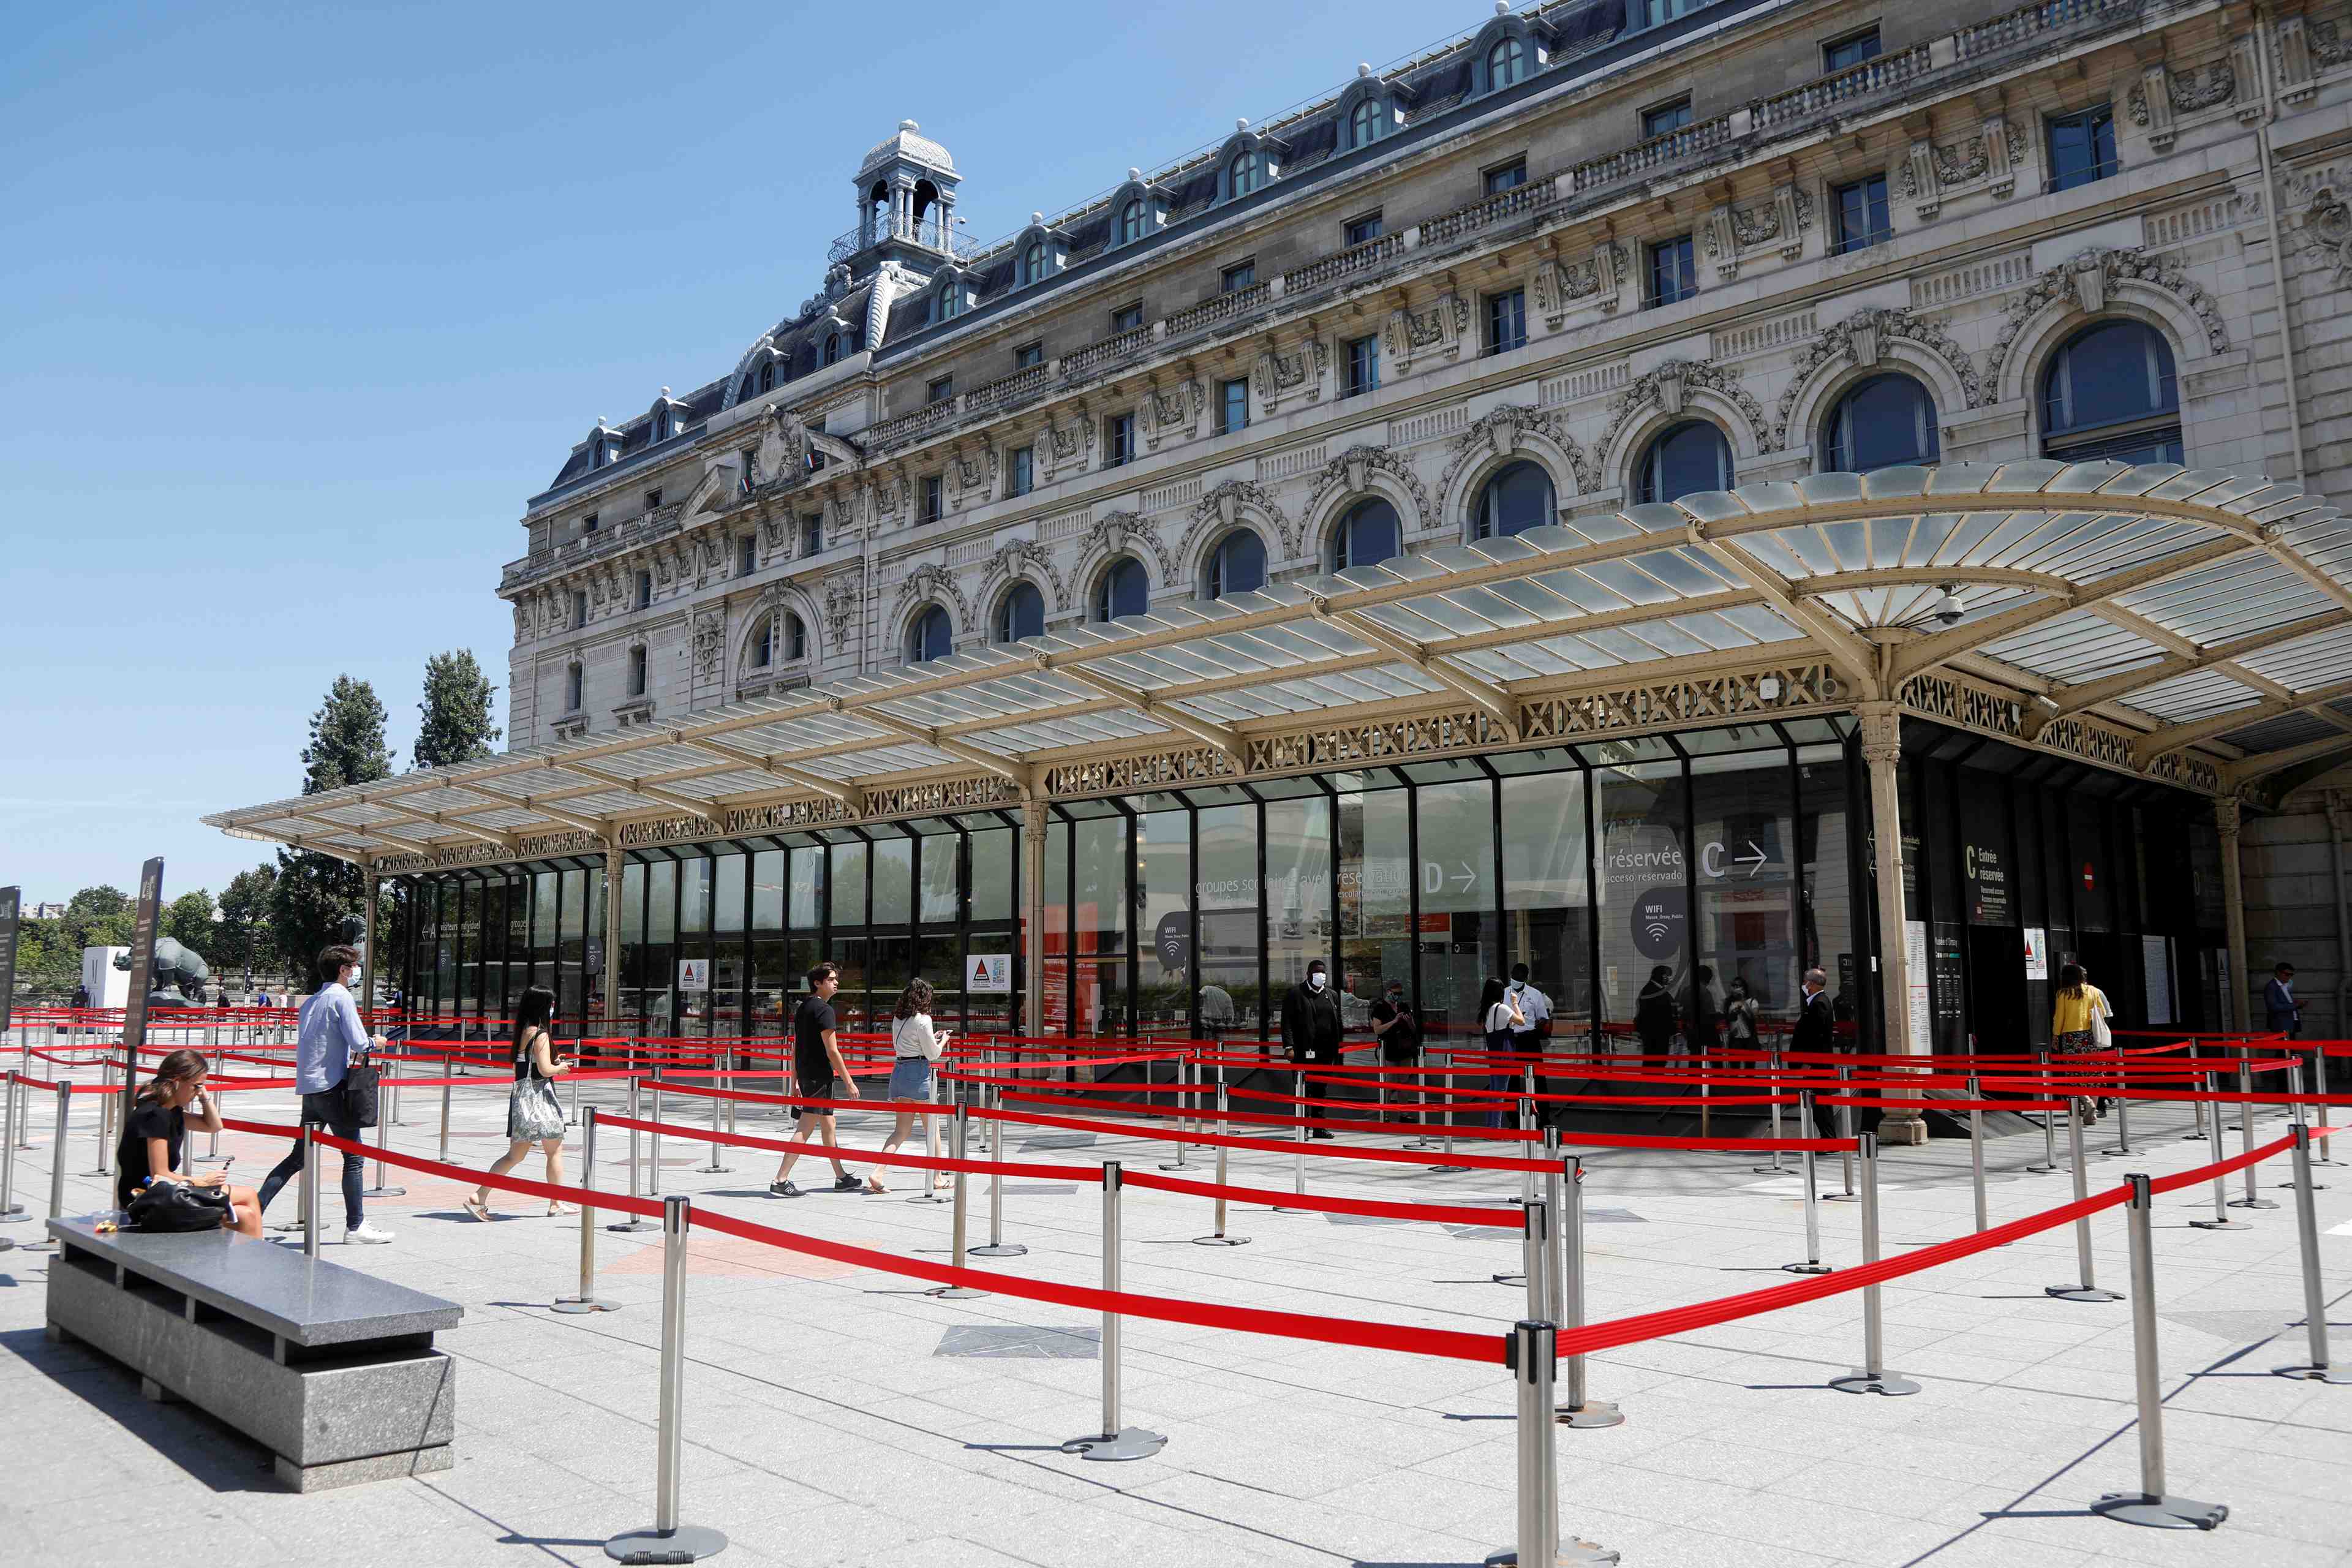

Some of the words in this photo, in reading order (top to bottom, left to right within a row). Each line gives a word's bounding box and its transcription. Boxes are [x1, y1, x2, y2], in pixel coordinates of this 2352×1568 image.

[1608, 845, 1681, 868] réservée
[1702, 842, 1725, 877] C
[1966, 845, 1976, 879] C
[1979, 847, 1997, 864] Entrée
[1425, 862, 1443, 893] D
[1638, 870, 1683, 882] reservado
[1980, 865, 2004, 882] réservée
[1196, 878, 1238, 897] groupes
[1645, 905, 1662, 913] WIFI
[430, 922, 435, 939] A
